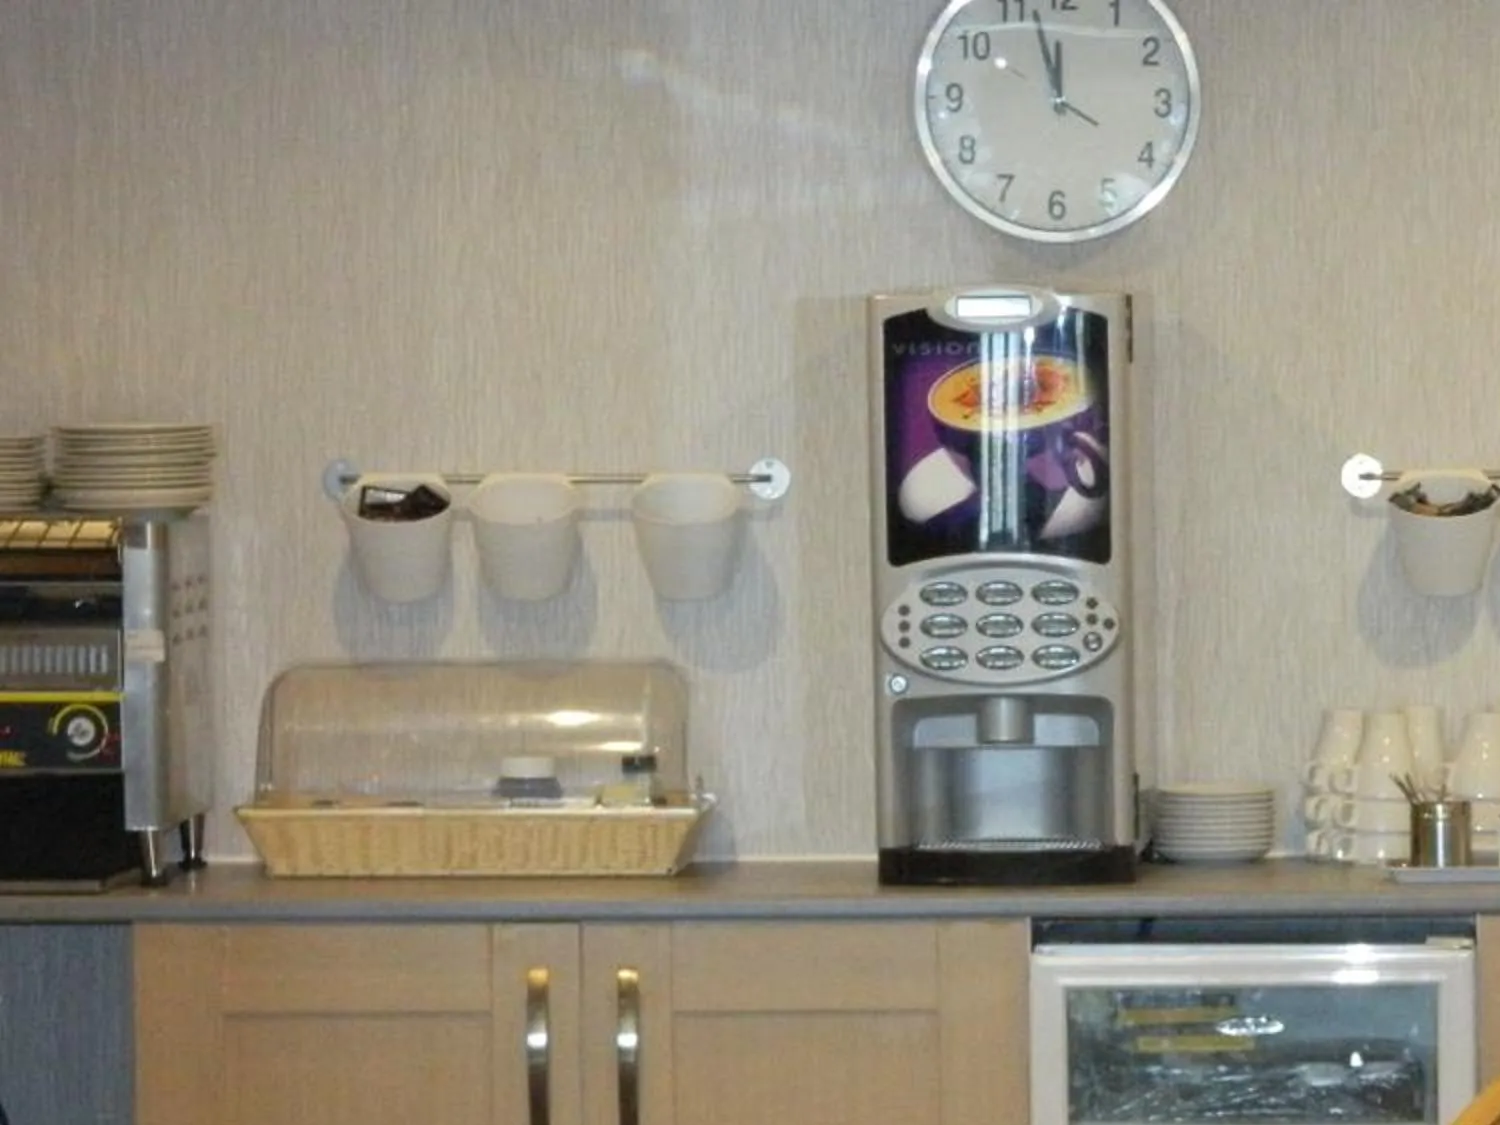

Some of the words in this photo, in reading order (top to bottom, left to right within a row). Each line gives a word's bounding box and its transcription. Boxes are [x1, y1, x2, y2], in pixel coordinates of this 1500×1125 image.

[1109, 0, 1120, 26] 1
[958, 31, 991, 61] 10
[1142, 37, 1160, 67] 2
[945, 83, 964, 112] 9
[1154, 88, 1172, 118] 3
[958, 135, 977, 164] 8
[1137, 141, 1155, 168] 4
[997, 174, 1015, 203] 7
[1100, 178, 1116, 207] 5
[1048, 191, 1066, 220] 6
